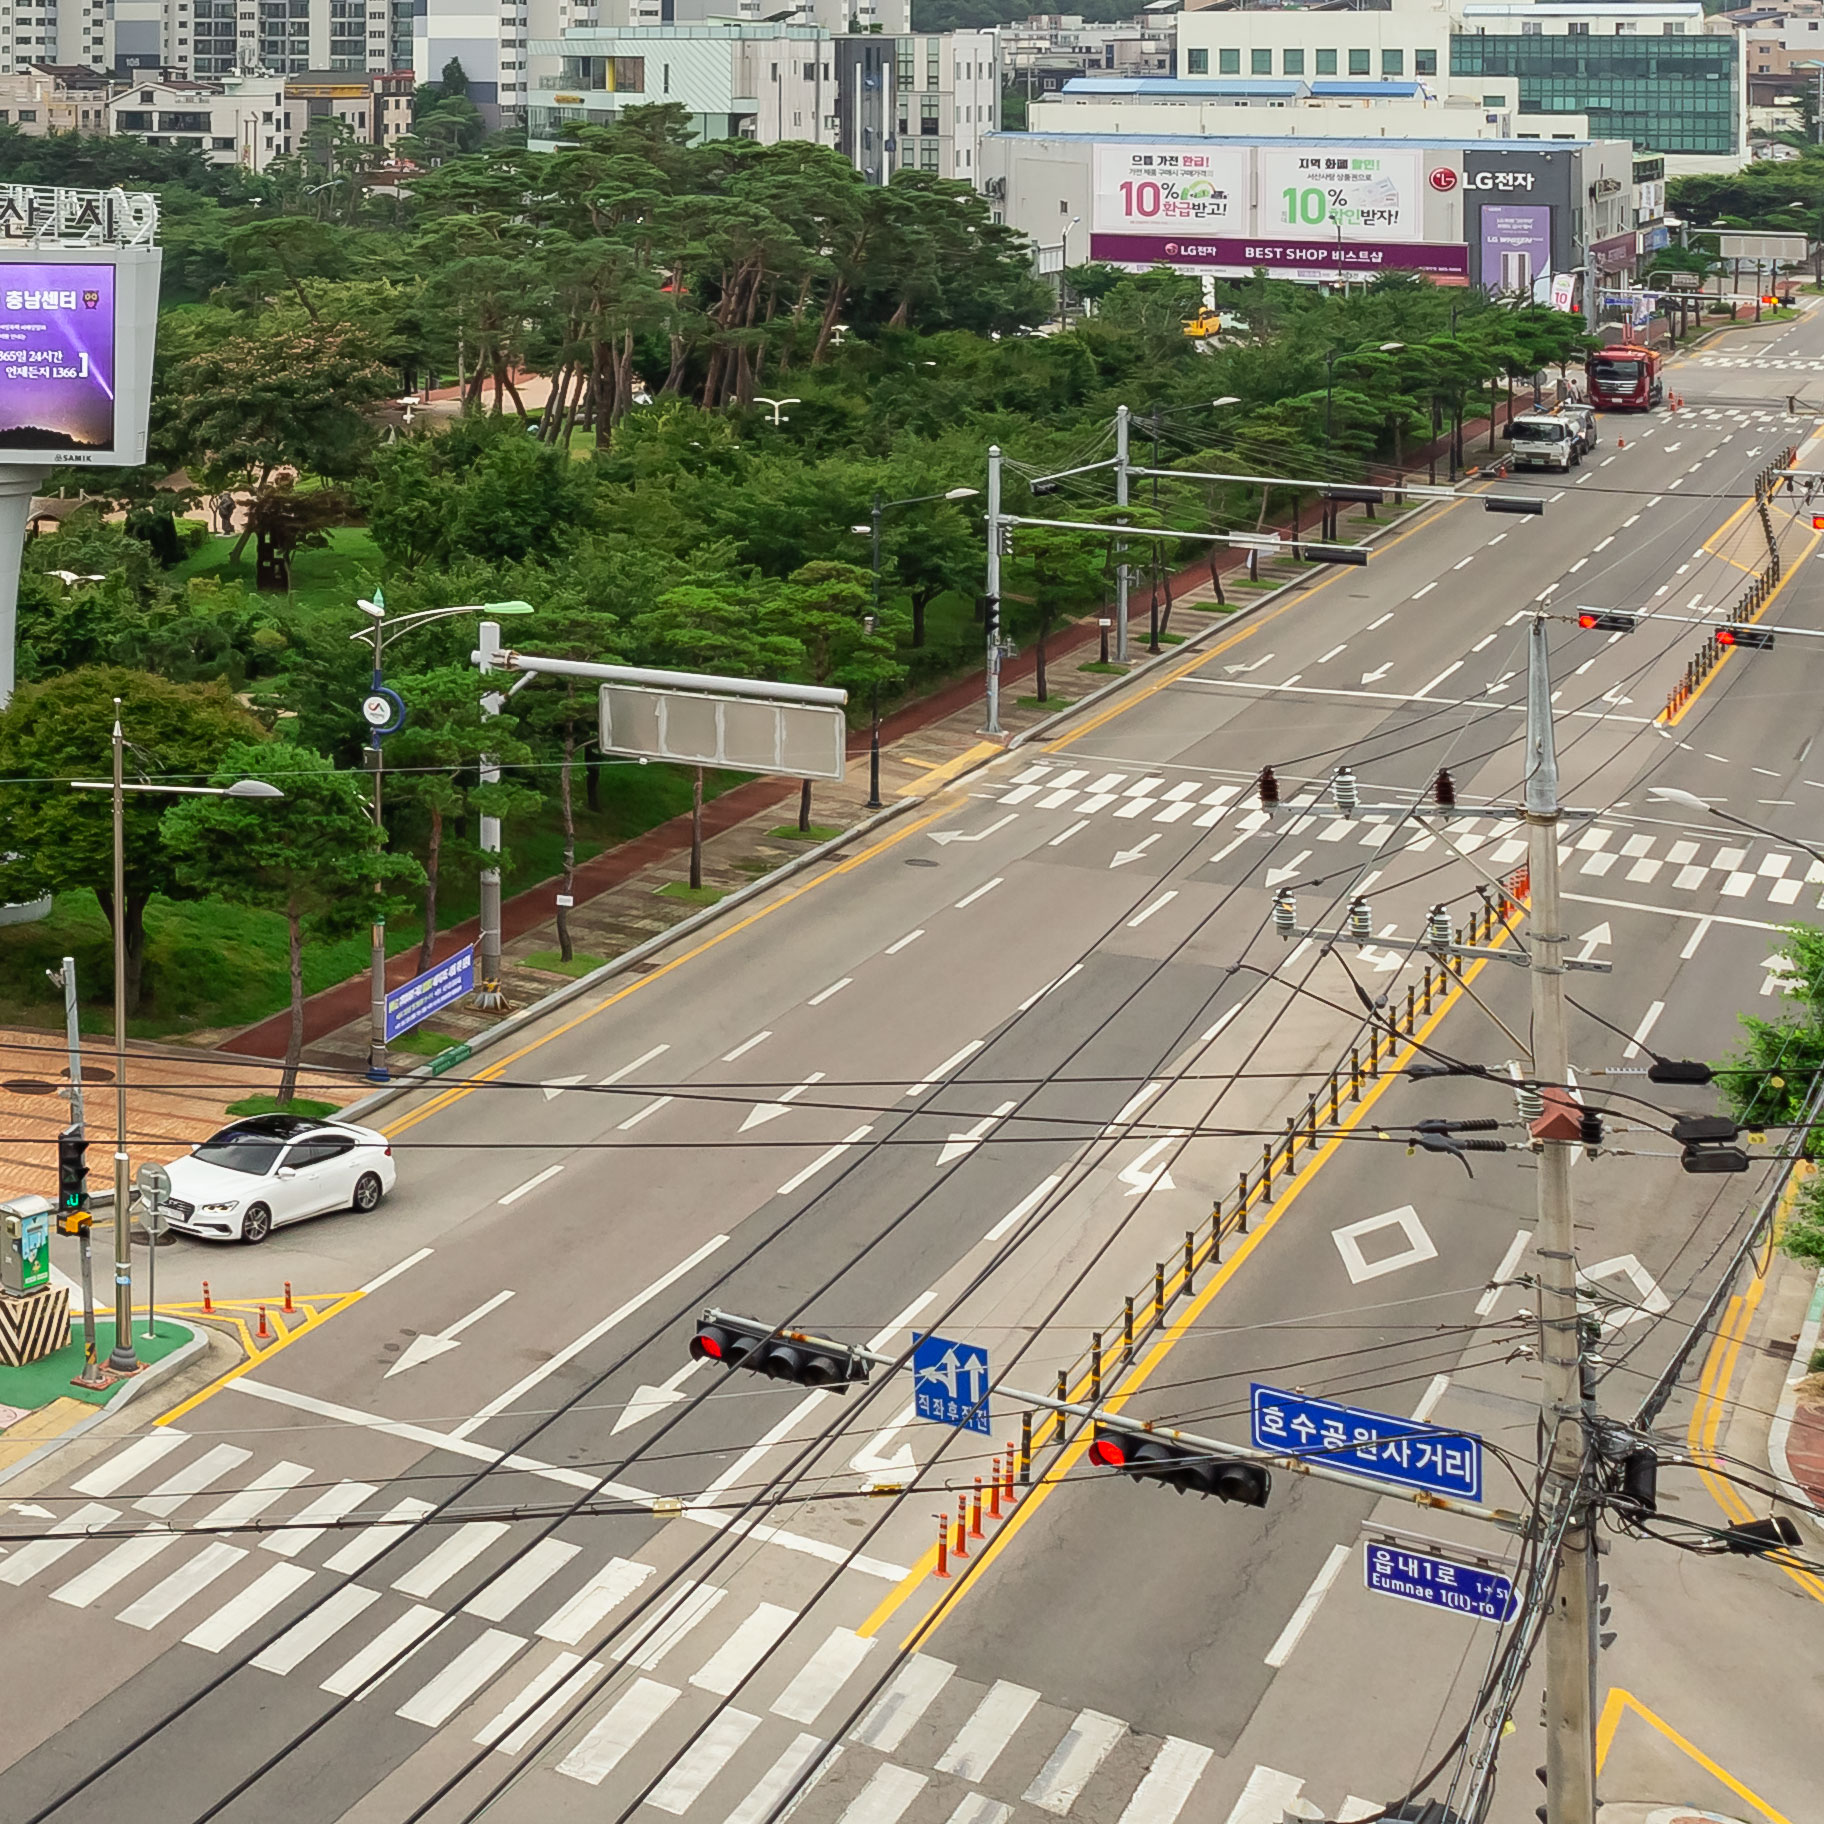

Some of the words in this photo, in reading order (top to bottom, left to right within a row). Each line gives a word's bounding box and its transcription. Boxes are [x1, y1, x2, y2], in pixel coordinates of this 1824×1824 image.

[1157, 156, 1179, 166] 가전
[1299, 158, 1321, 169] 지역
[1463, 172, 1535, 191] LG전자
[1120, 180, 1179, 217] 10%
[1282, 187, 1348, 225] 10%
[1162, 201, 1227, 218] 환급받고!
[1181, 245, 1216, 256] LG전자
[1245, 247, 1283, 259] BEST
[1286, 248, 1328, 261] SHOP
[5, 290, 77, 310] 충남센터
[52, 366, 77, 378] 1366
[1260, 1407, 1473, 1483] 호수공원사거리
[1372, 1550, 1459, 1589] 읍내1로
[1371, 1572, 1434, 1604] Eumnae
